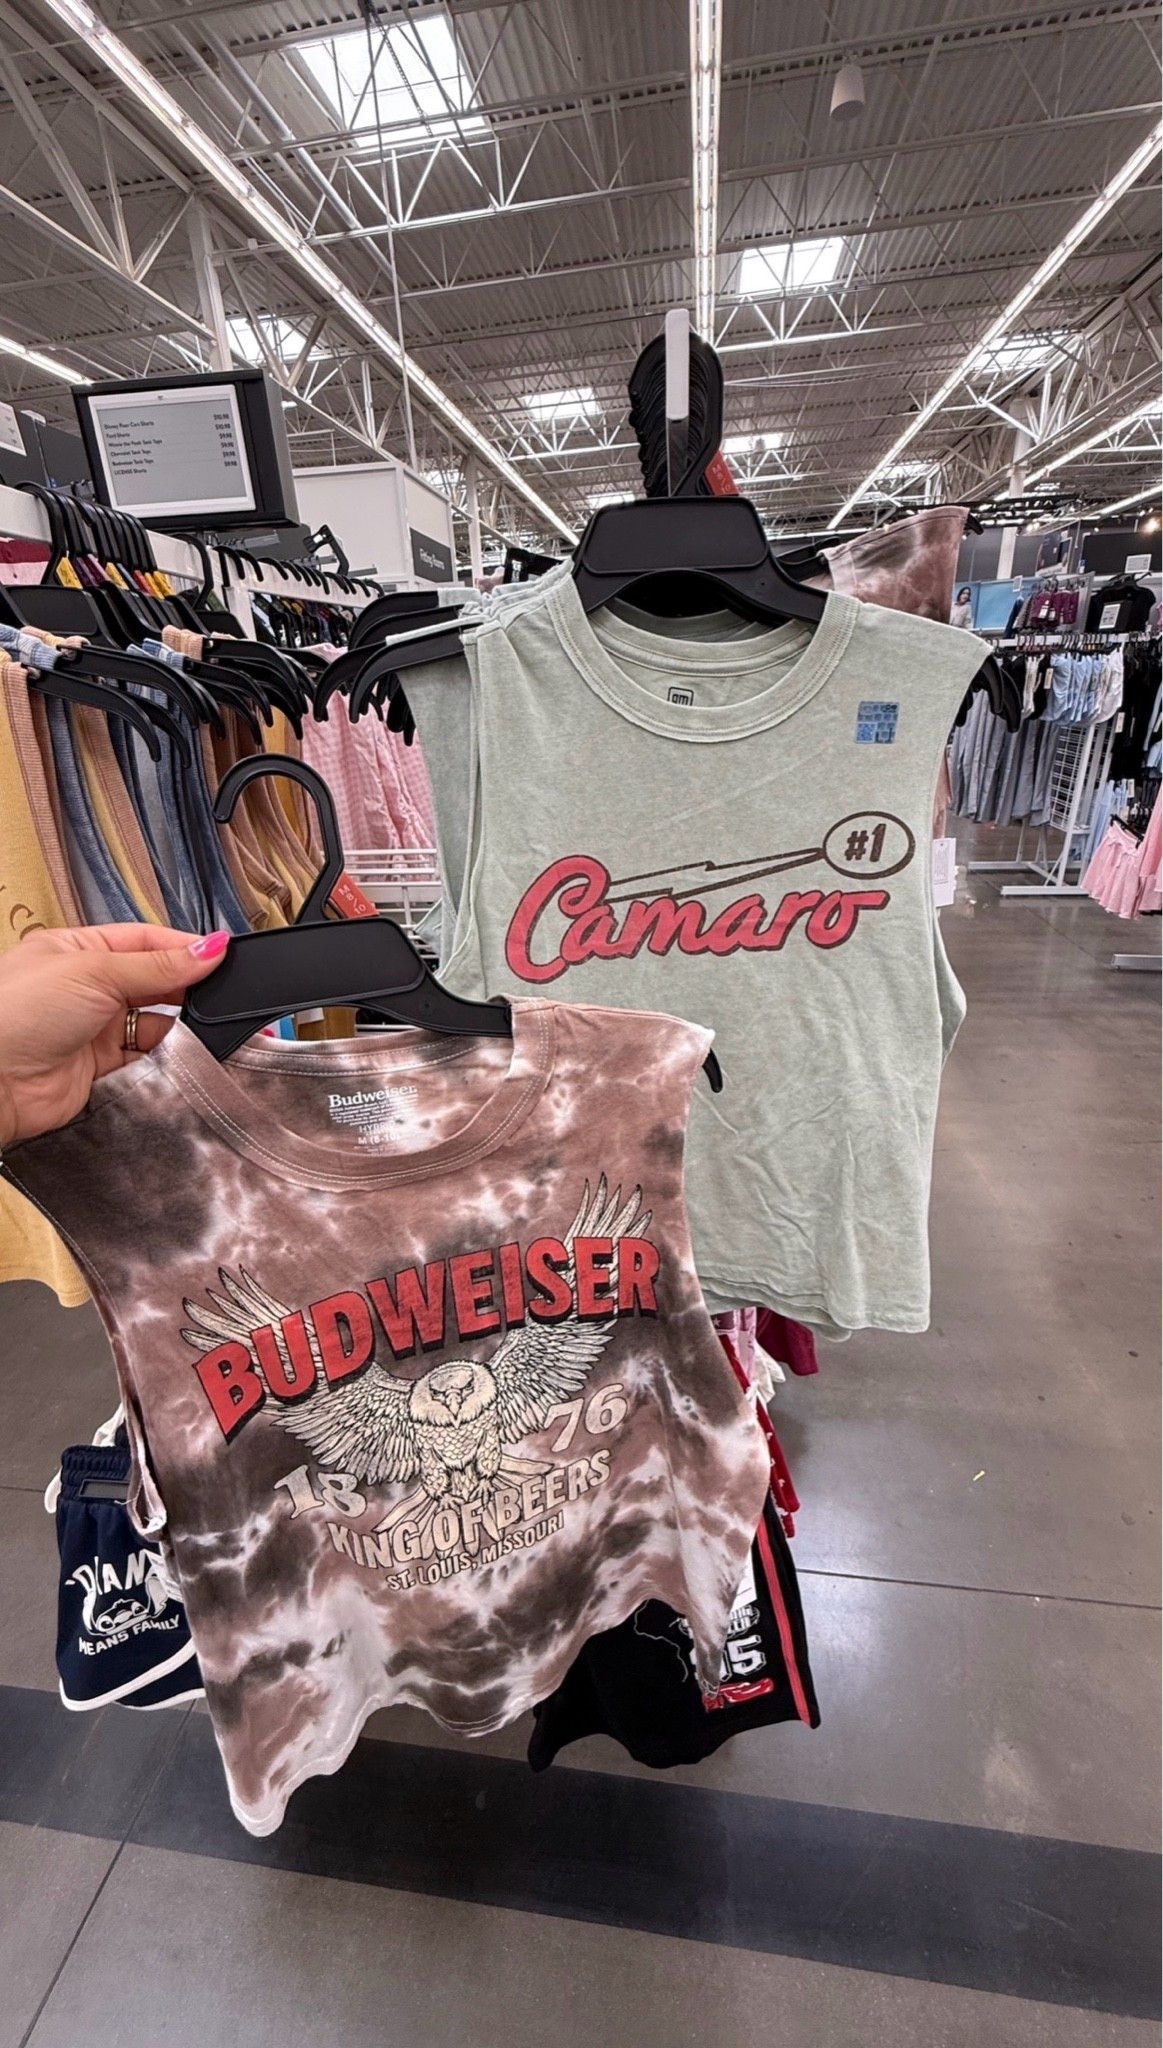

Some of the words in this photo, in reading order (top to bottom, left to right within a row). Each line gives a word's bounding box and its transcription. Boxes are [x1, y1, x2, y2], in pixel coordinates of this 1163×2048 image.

[845, 823, 886, 862] #1
[504, 854, 890, 984] Camaro
[195, 1236, 661, 1444] BUDWEISER
[273, 1463, 368, 1520] 18
[544, 1382, 628, 1453] 76
[326, 1521, 422, 1570] KING
[432, 1500, 483, 1552] OF
[494, 1449, 611, 1531] BEERS
[386, 1569, 416, 1591] ST.
[418, 1552, 478, 1585] LOUIS,
[482, 1509, 565, 1565] MISSOURI
[78, 1629, 130, 1656] MEANS
[132, 1614, 180, 1636] FAMILY
